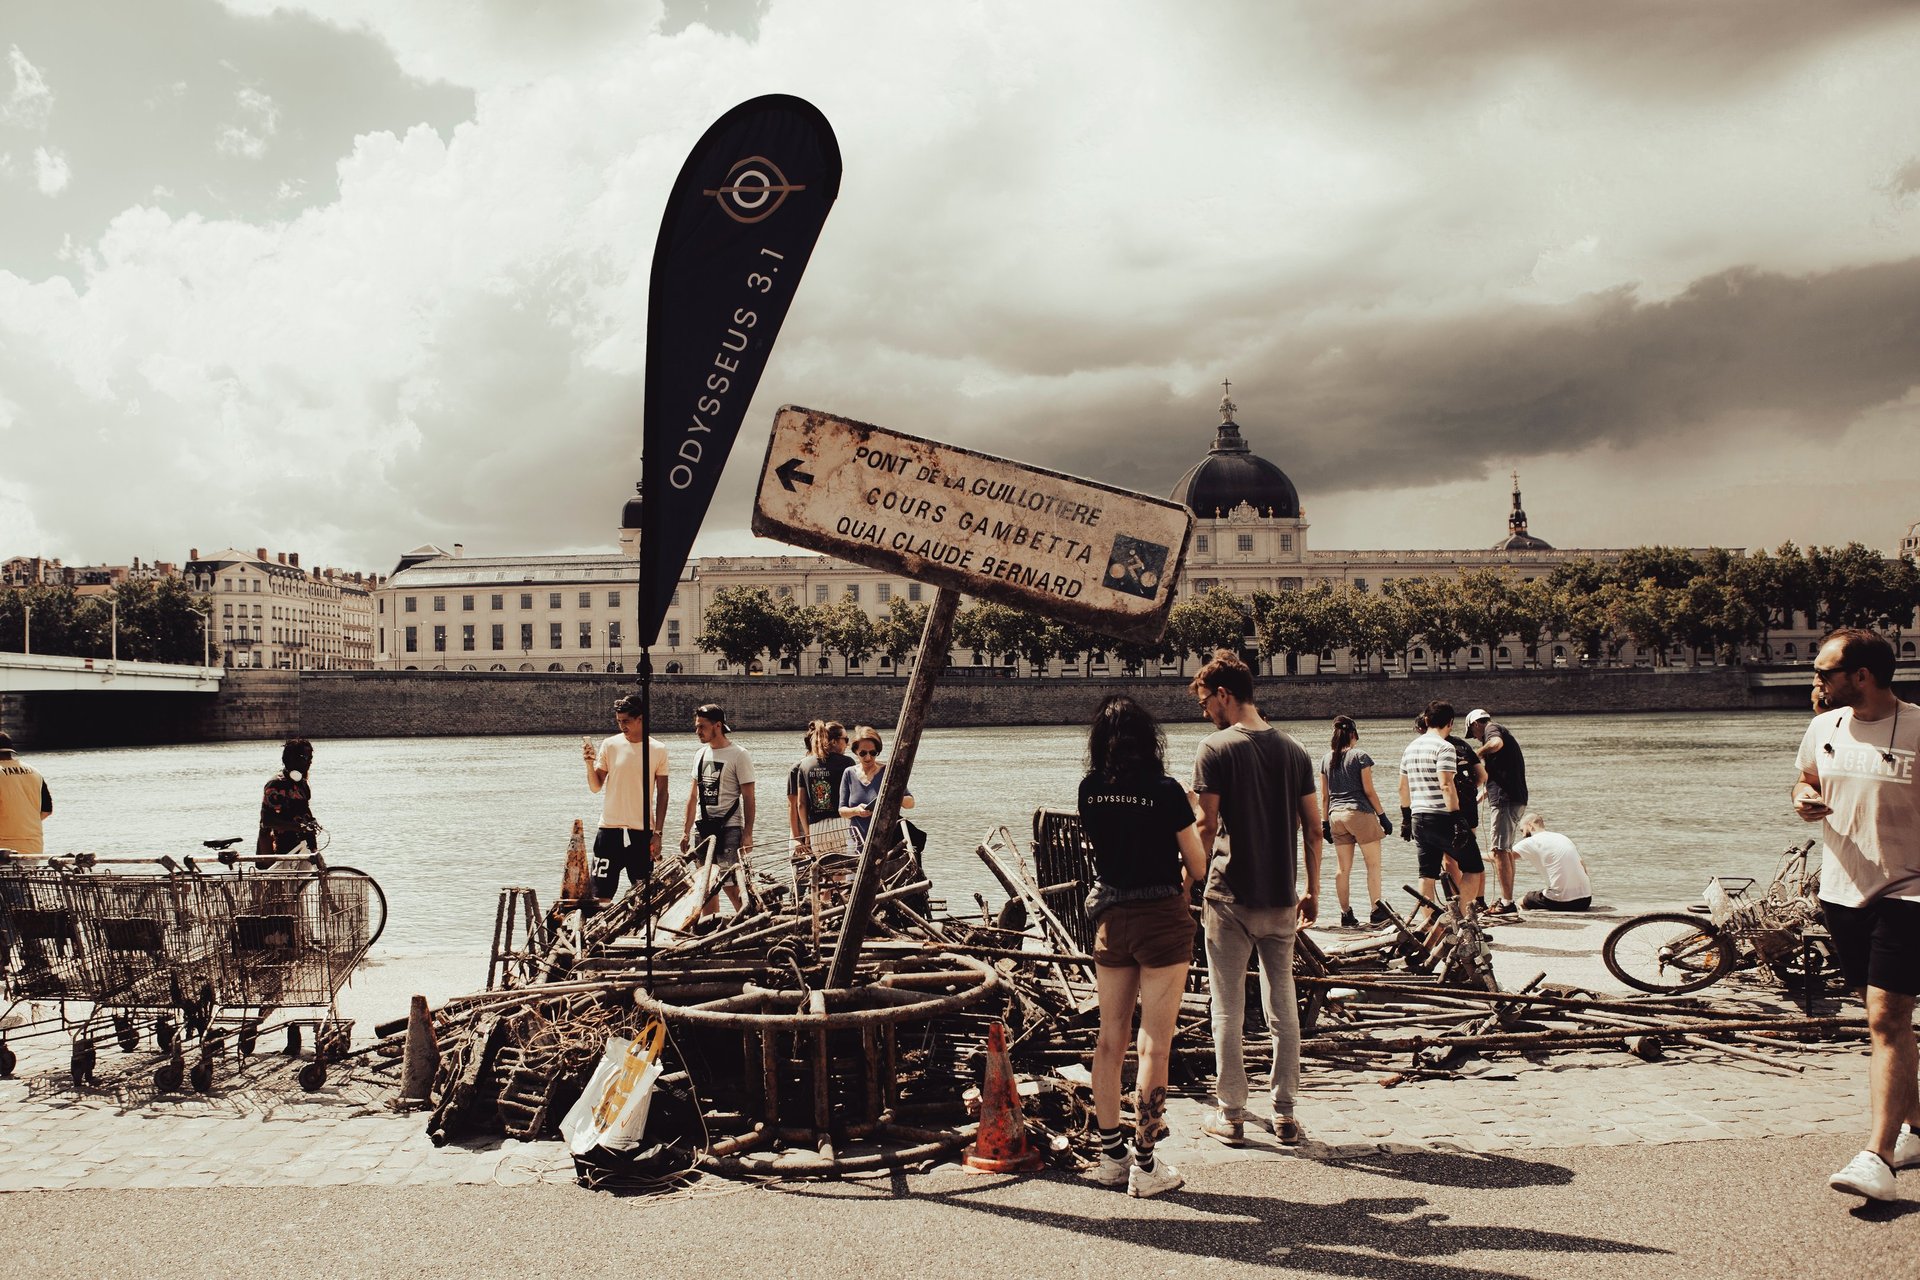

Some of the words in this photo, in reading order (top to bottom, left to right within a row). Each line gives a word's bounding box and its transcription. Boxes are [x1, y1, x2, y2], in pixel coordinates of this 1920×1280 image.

[669, 308, 758, 490] ODYSSEUS
[747, 247, 784, 294] 3.1
[852, 446, 913, 476] PONT
[916, 466, 941, 485] DE
[943, 475, 966, 492] LA
[836, 516, 887, 544] QUAI
[892, 531, 974, 569] CLAUDE
[980, 556, 1083, 599] BERNARD
[866, 487, 947, 523] COURS
[958, 511, 1093, 565] GAMBETTA
[1141, 797, 1154, 807] 3.1
